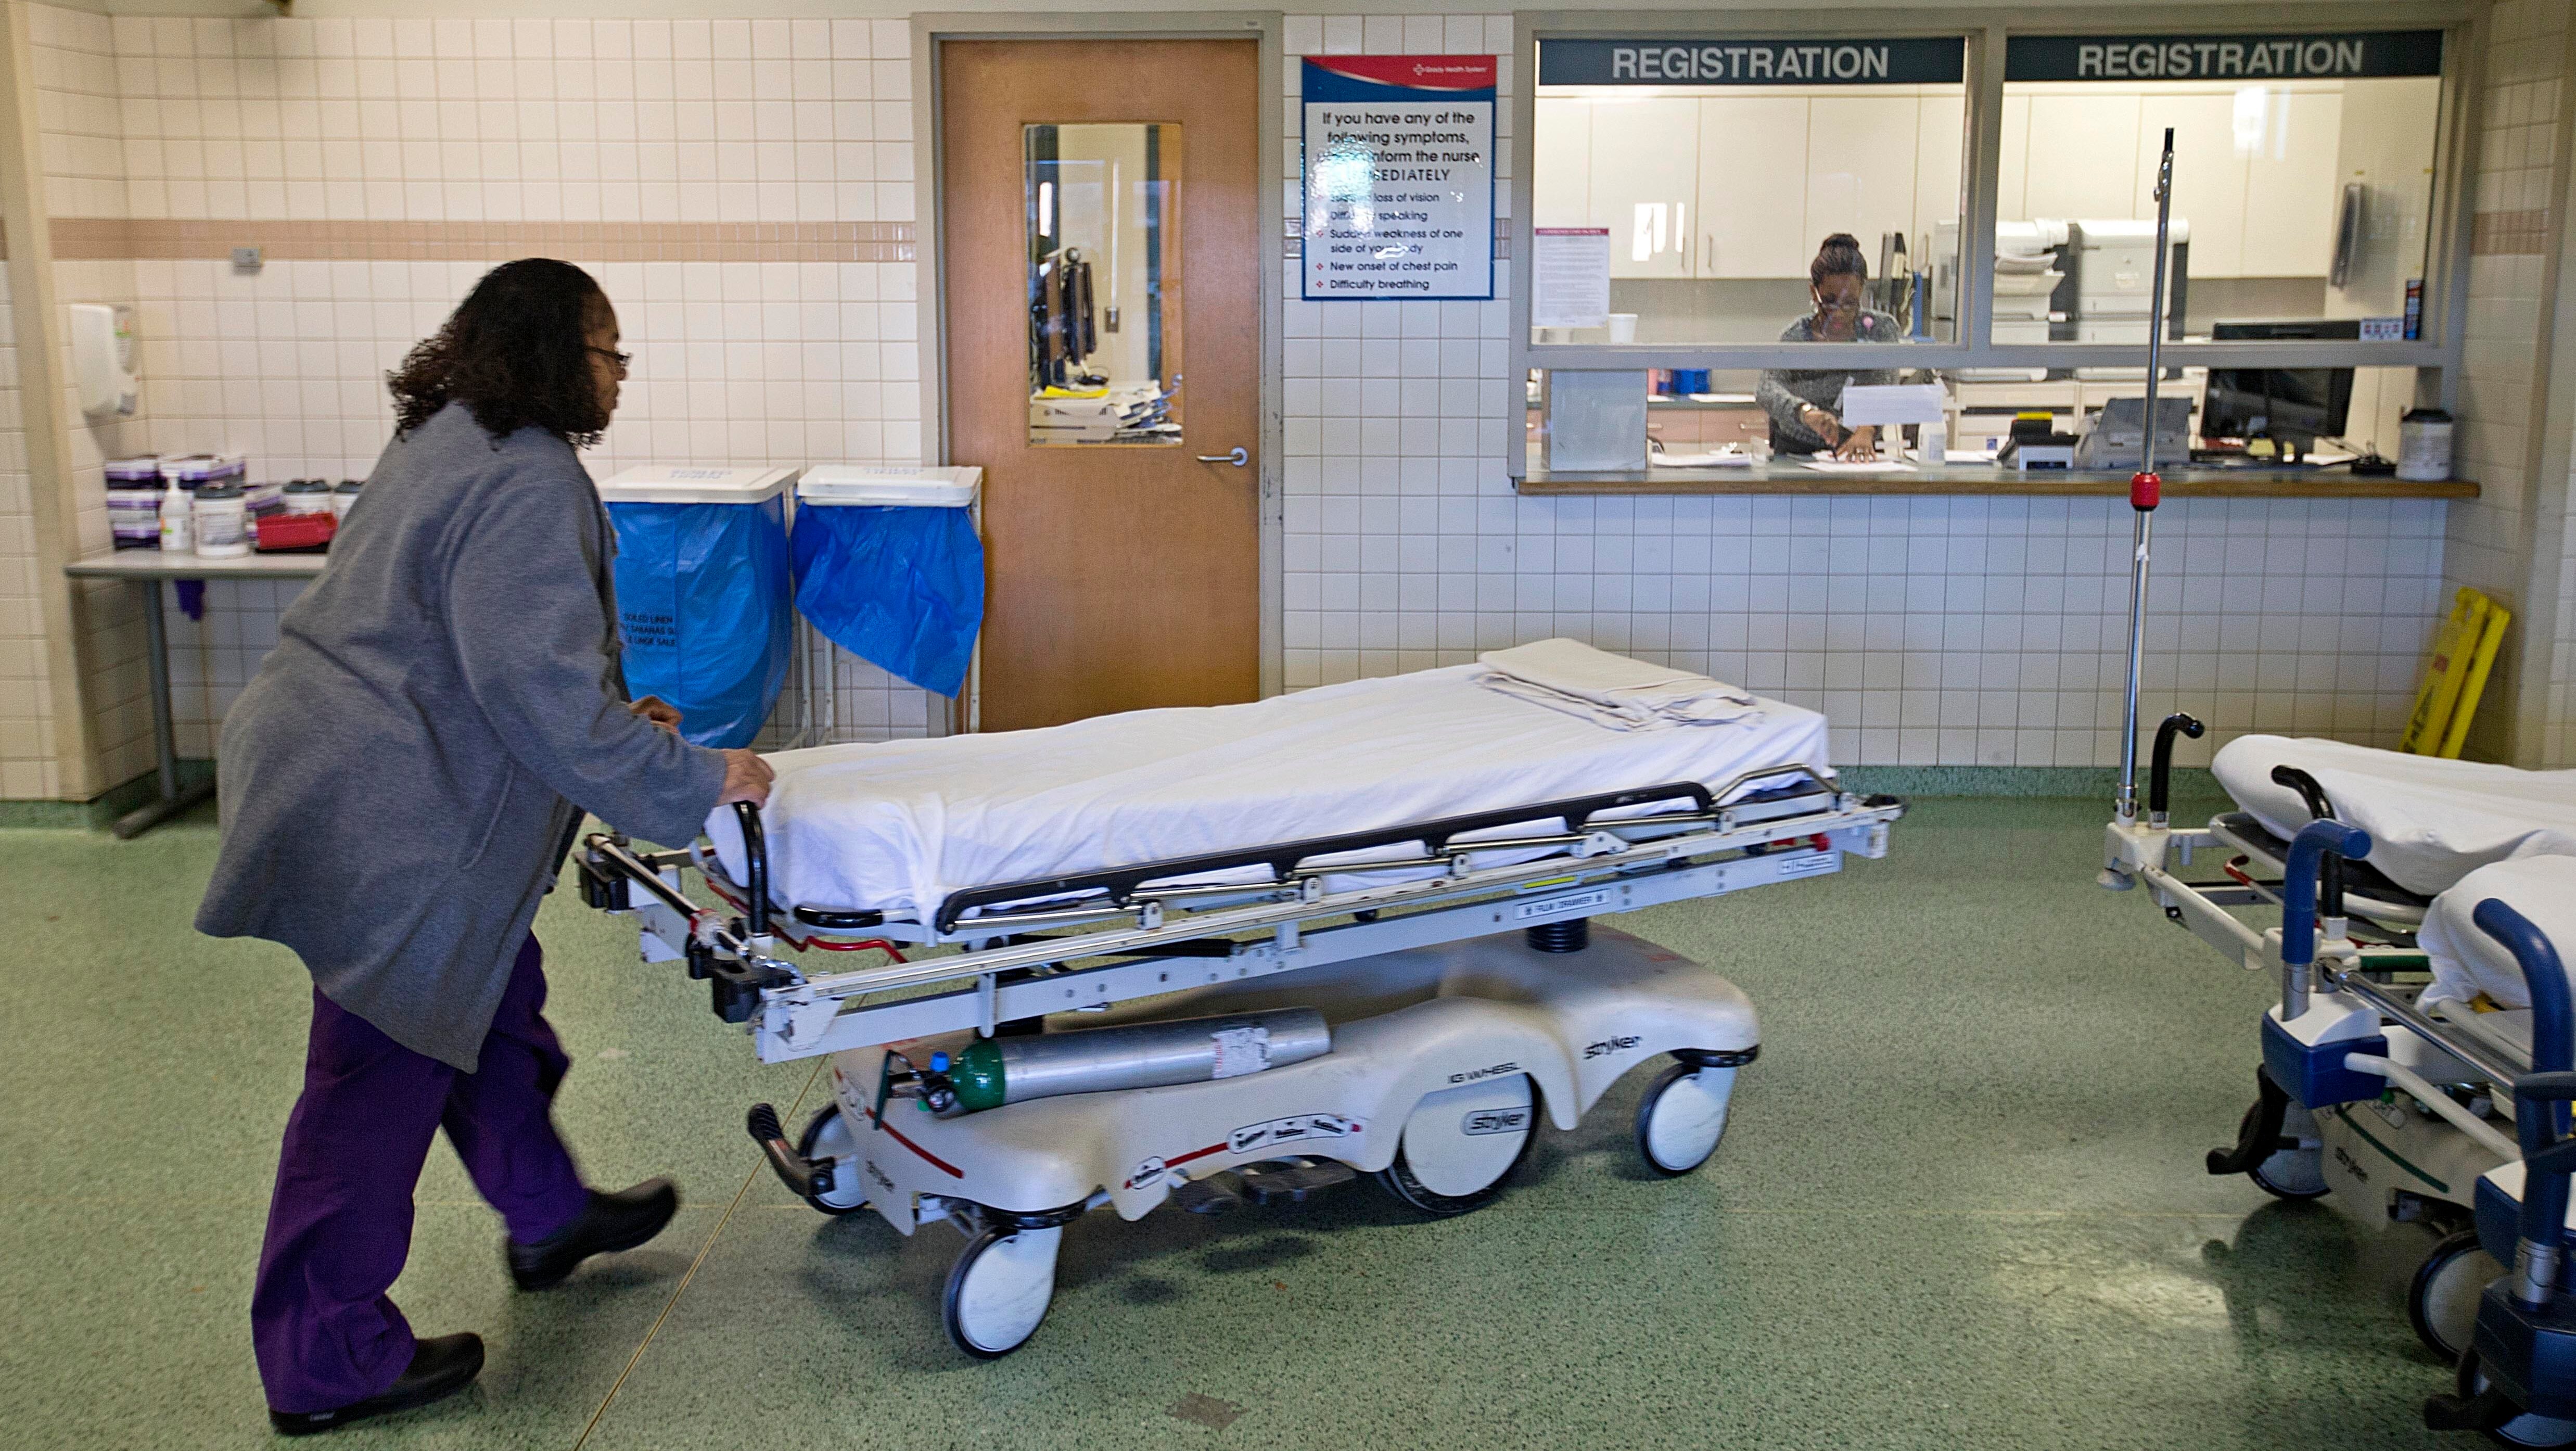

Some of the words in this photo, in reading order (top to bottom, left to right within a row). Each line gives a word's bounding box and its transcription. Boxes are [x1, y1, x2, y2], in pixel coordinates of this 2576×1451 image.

[1613, 47, 1889, 79] REGISTRATION
[2077, 40, 2364, 77] REGISTRATION
[1322, 112, 1331, 124] If
[1335, 114, 1361, 126] you
[1365, 112, 1400, 124] have
[1405, 114, 1431, 126] any
[1435, 112, 1449, 123] of
[1452, 112, 1475, 123] the
[1394, 131, 1470, 145] symptoms,
[1415, 150, 1438, 162] the
[1442, 151, 1480, 162] nurse
[1374, 193, 1393, 202] loss
[1396, 193, 1407, 202] of
[1409, 193, 1440, 202] vision
[1379, 210, 1427, 222] speaking
[1374, 229, 1426, 238] weakness
[1430, 229, 1440, 238] of
[1443, 230, 1464, 238] one
[1331, 244, 1352, 253] side
[1356, 244, 1366, 253] of
[1330, 262, 1353, 271] New
[1357, 262, 1386, 271] onset
[1389, 262, 1400, 271] of
[1402, 262, 1431, 271] chest
[1434, 261, 1458, 272] pain
[1330, 279, 1375, 291] Difficulty
[1378, 279, 1430, 291] breathing
